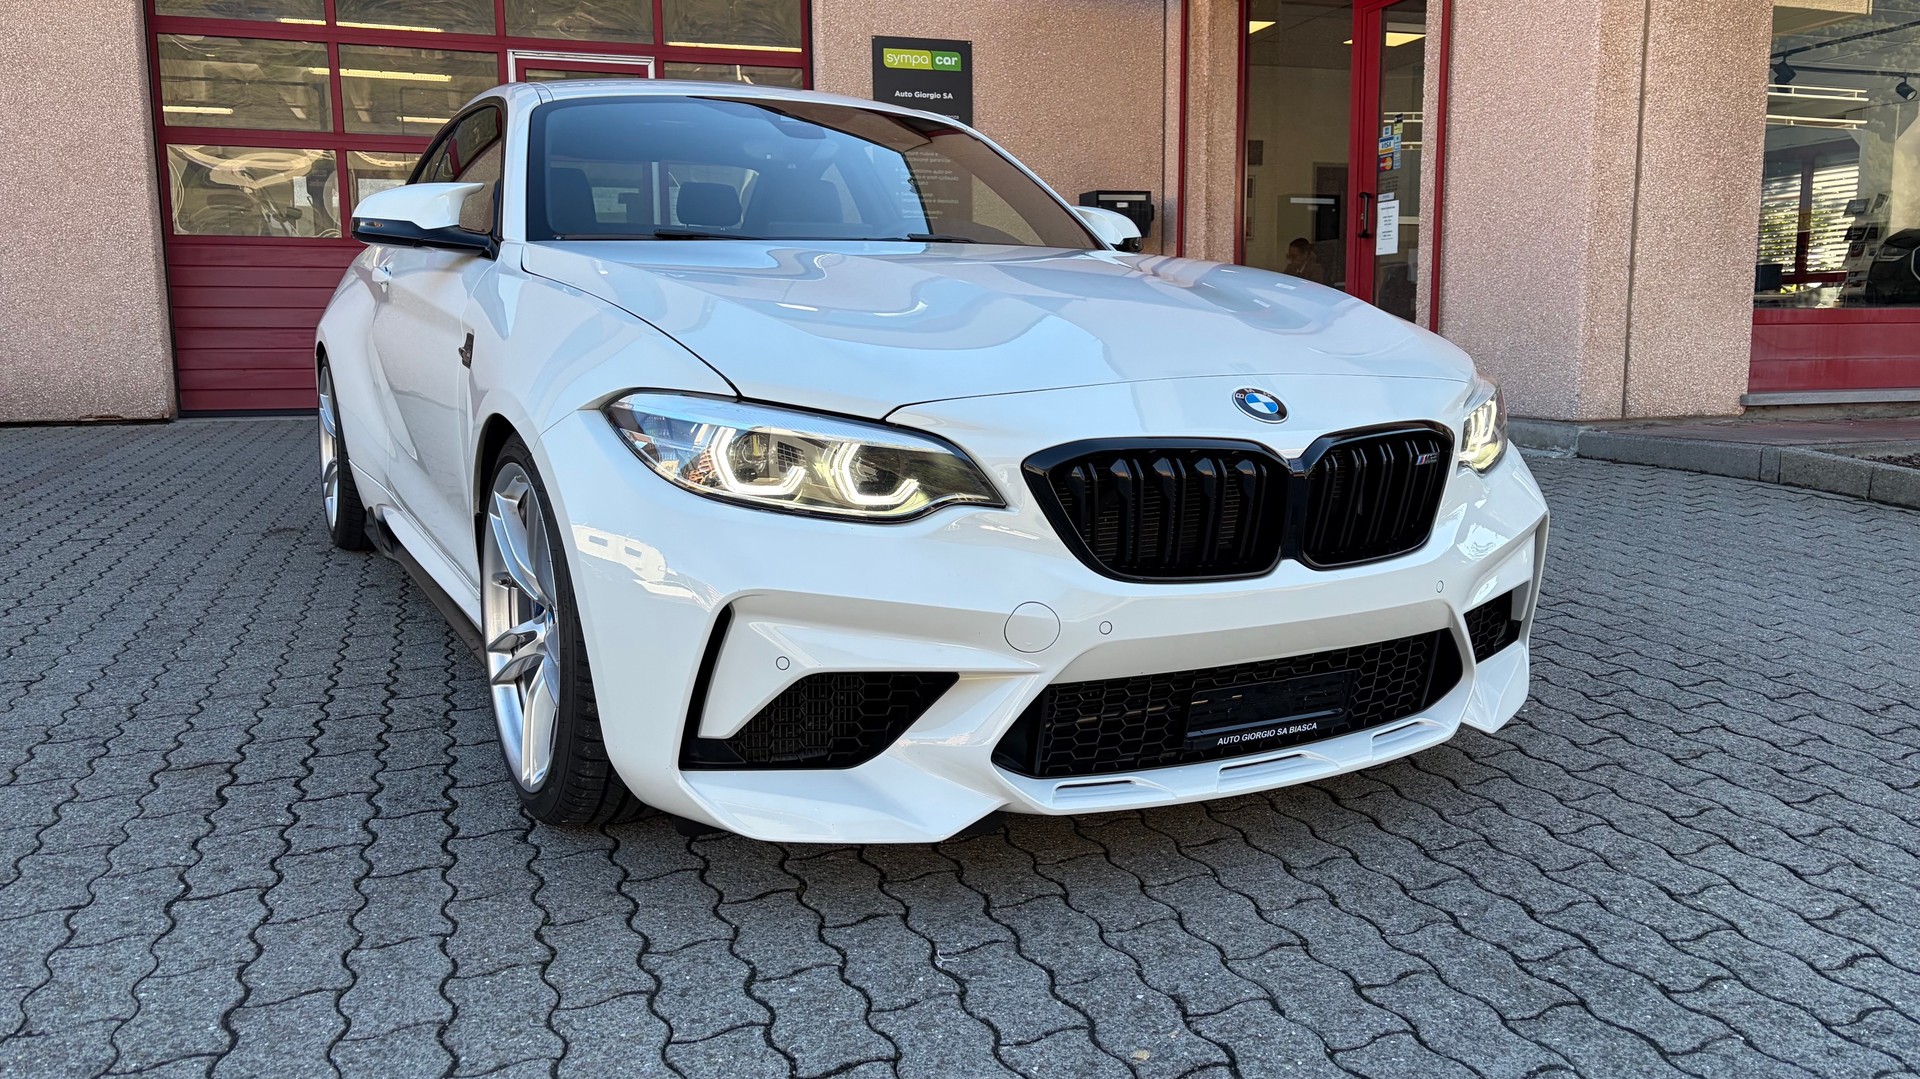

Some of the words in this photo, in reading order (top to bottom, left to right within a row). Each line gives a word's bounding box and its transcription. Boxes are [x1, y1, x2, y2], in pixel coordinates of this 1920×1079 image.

[886, 53, 929, 66] sympa
[935, 56, 958, 66] car
[894, 90, 913, 98] Auto
[914, 91, 942, 100] Giorgio
[942, 92, 954, 100] SA
[1217, 735, 1240, 746] AUTO
[1241, 730, 1276, 742] GIORGIO
[1277, 727, 1288, 736] SA
[1289, 722, 1318, 734] BIASCA
